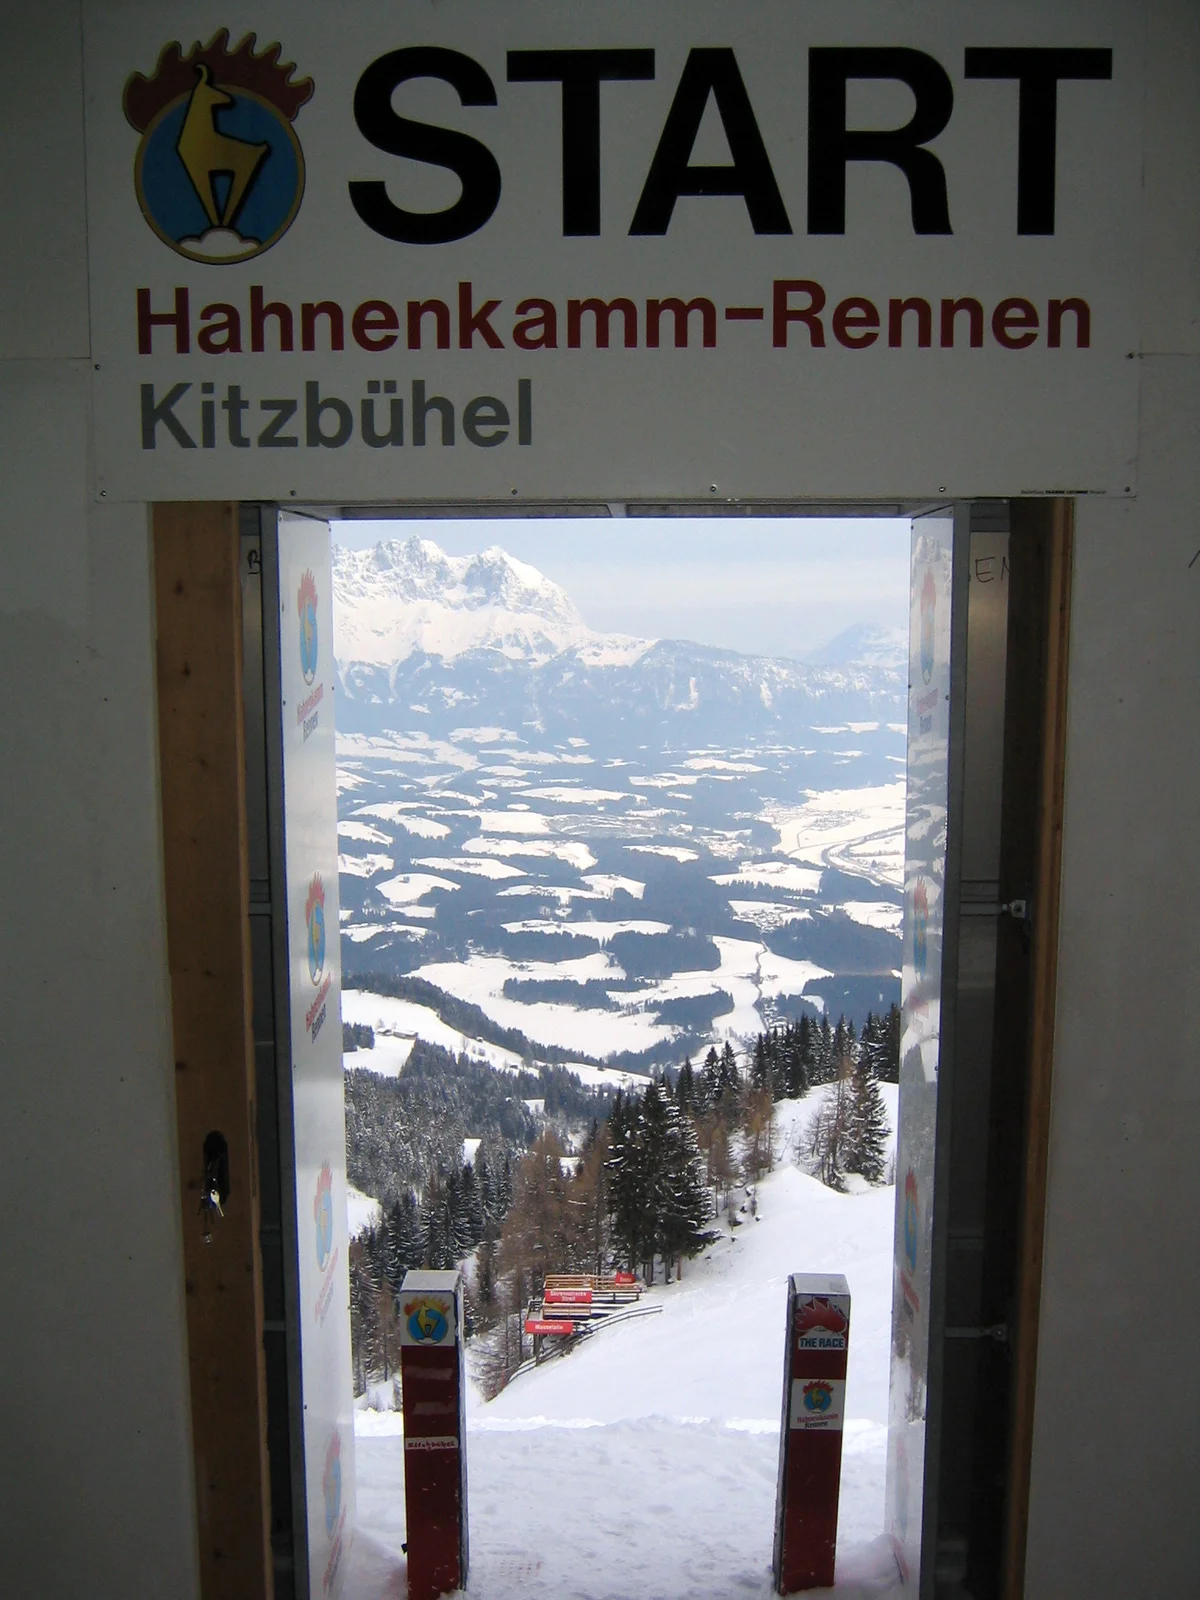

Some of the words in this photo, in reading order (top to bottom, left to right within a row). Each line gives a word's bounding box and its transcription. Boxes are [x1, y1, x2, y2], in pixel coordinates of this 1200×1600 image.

[347, 45, 1113, 245] START
[136, 279, 1091, 355] Hahnenkamm-Rennen
[140, 378, 533, 450] Kitzbühel
[800, 1338, 817, 1348] THE
[819, 1338, 844, 1348] RACE
